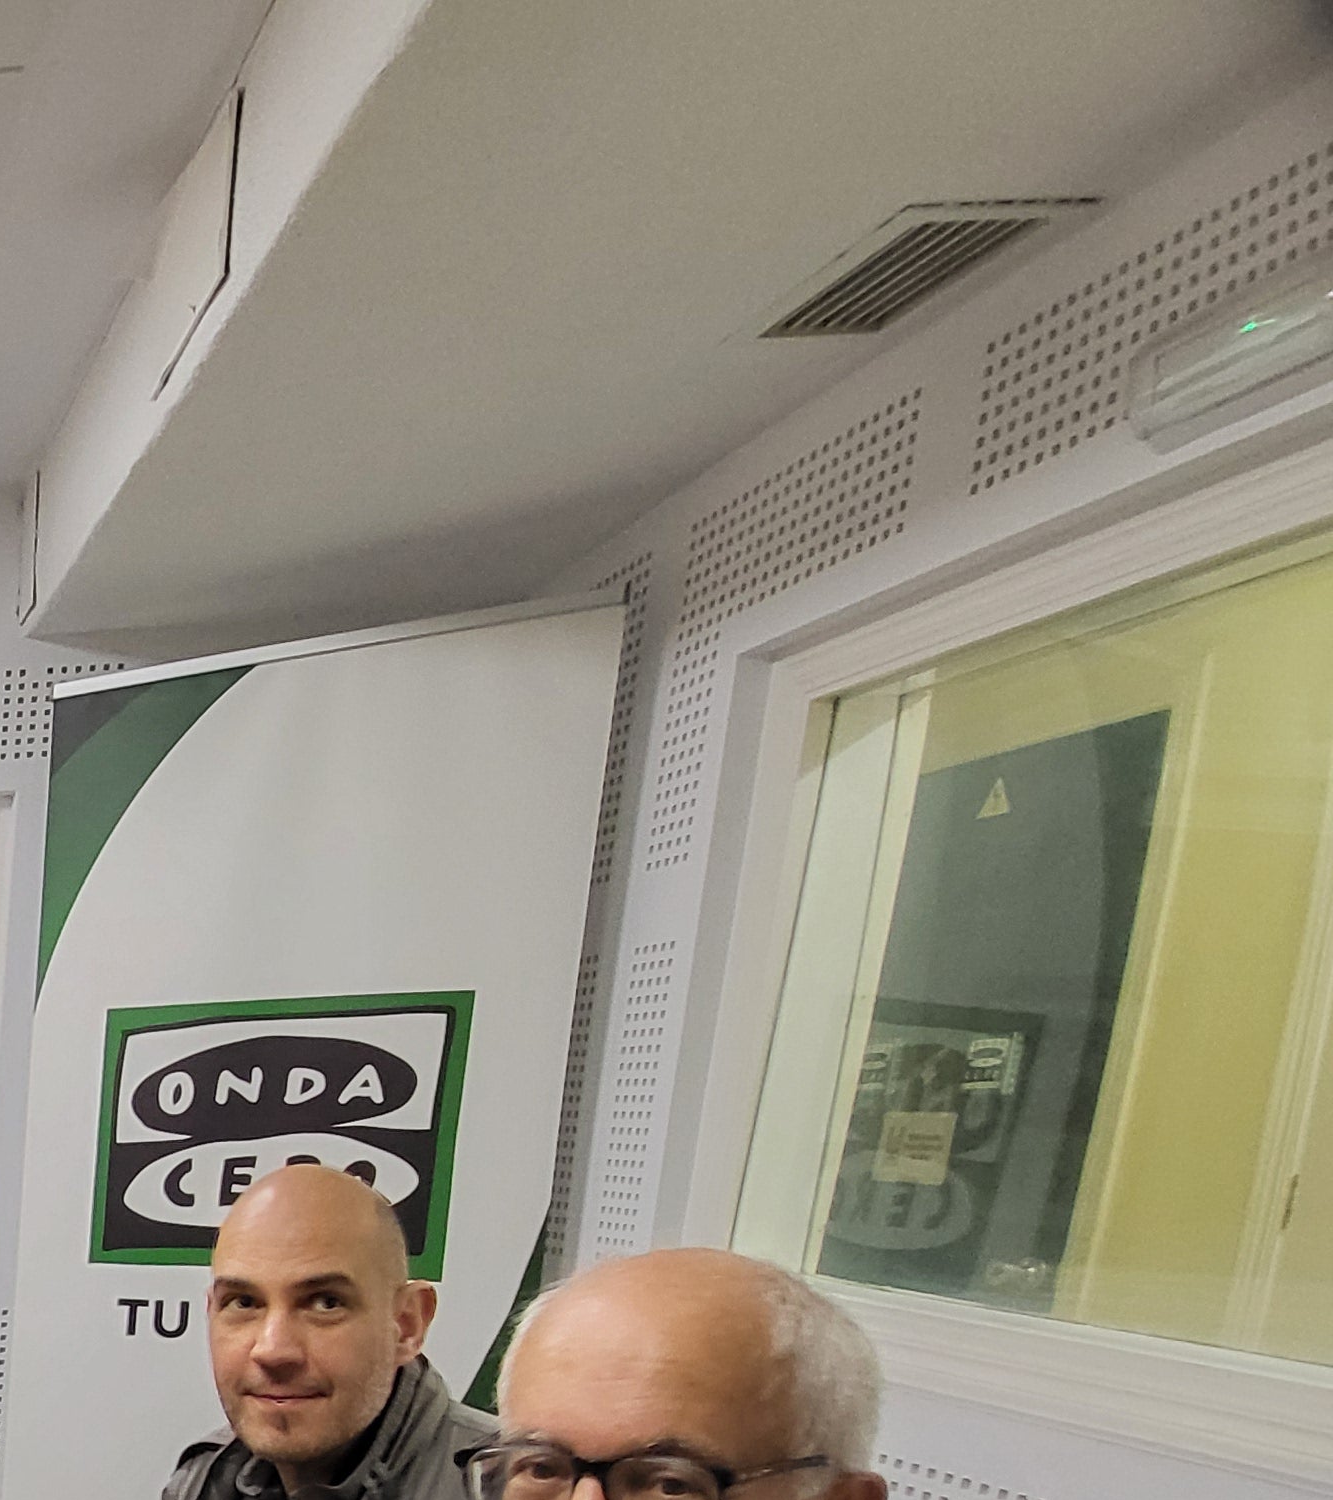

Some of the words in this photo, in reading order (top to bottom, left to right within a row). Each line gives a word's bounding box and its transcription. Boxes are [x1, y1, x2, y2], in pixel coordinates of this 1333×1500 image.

[156, 1063, 385, 1115] ONDA
[163, 1154, 377, 1207] CE
[117, 1298, 190, 1338] TU
